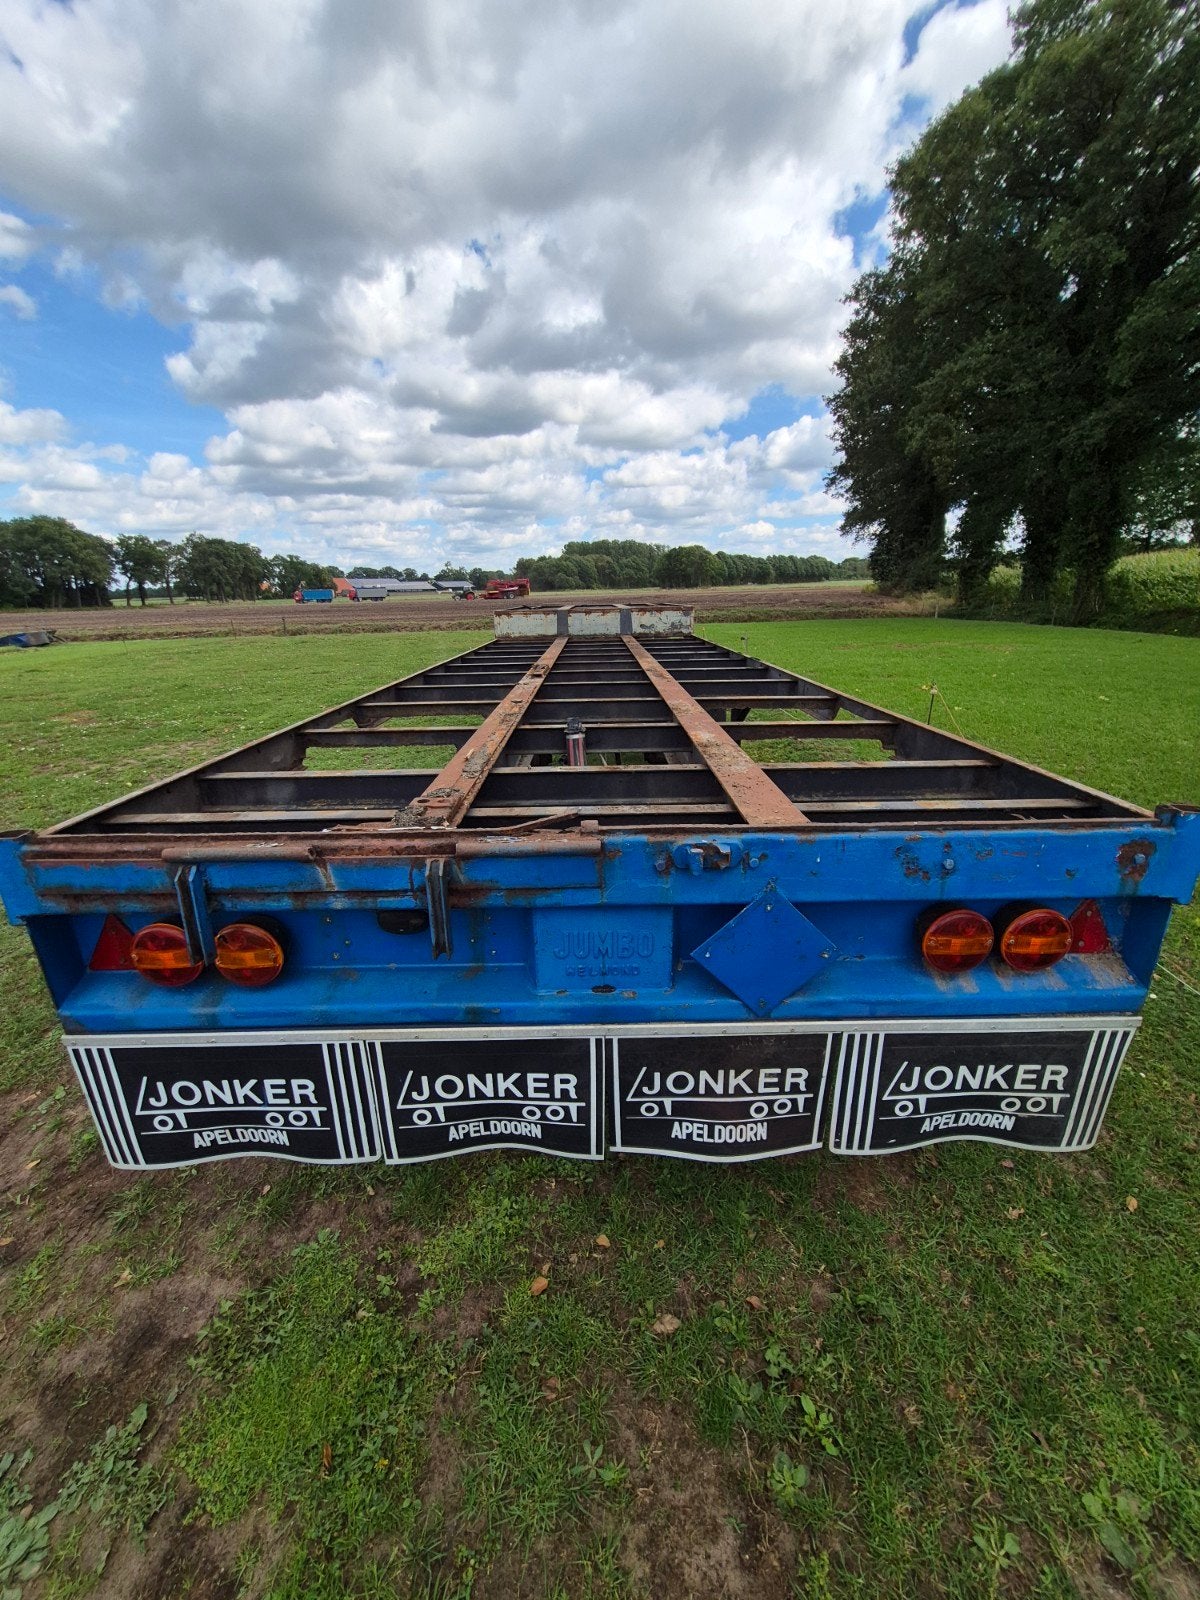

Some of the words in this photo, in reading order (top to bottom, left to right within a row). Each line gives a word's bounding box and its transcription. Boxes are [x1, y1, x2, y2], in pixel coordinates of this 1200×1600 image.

[553, 931, 655, 960] JUMBO
[412, 1072, 578, 1103] JONKER
[641, 1067, 809, 1096] JONKER
[899, 1063, 1069, 1093] JONKER
[148, 1078, 319, 1108] JONKER
[193, 1125, 290, 1149] APELDOORN
[448, 1119, 542, 1142] APELDOORN
[671, 1121, 768, 1144] APELDOORN
[920, 1112, 1016, 1134] APELDOORN
